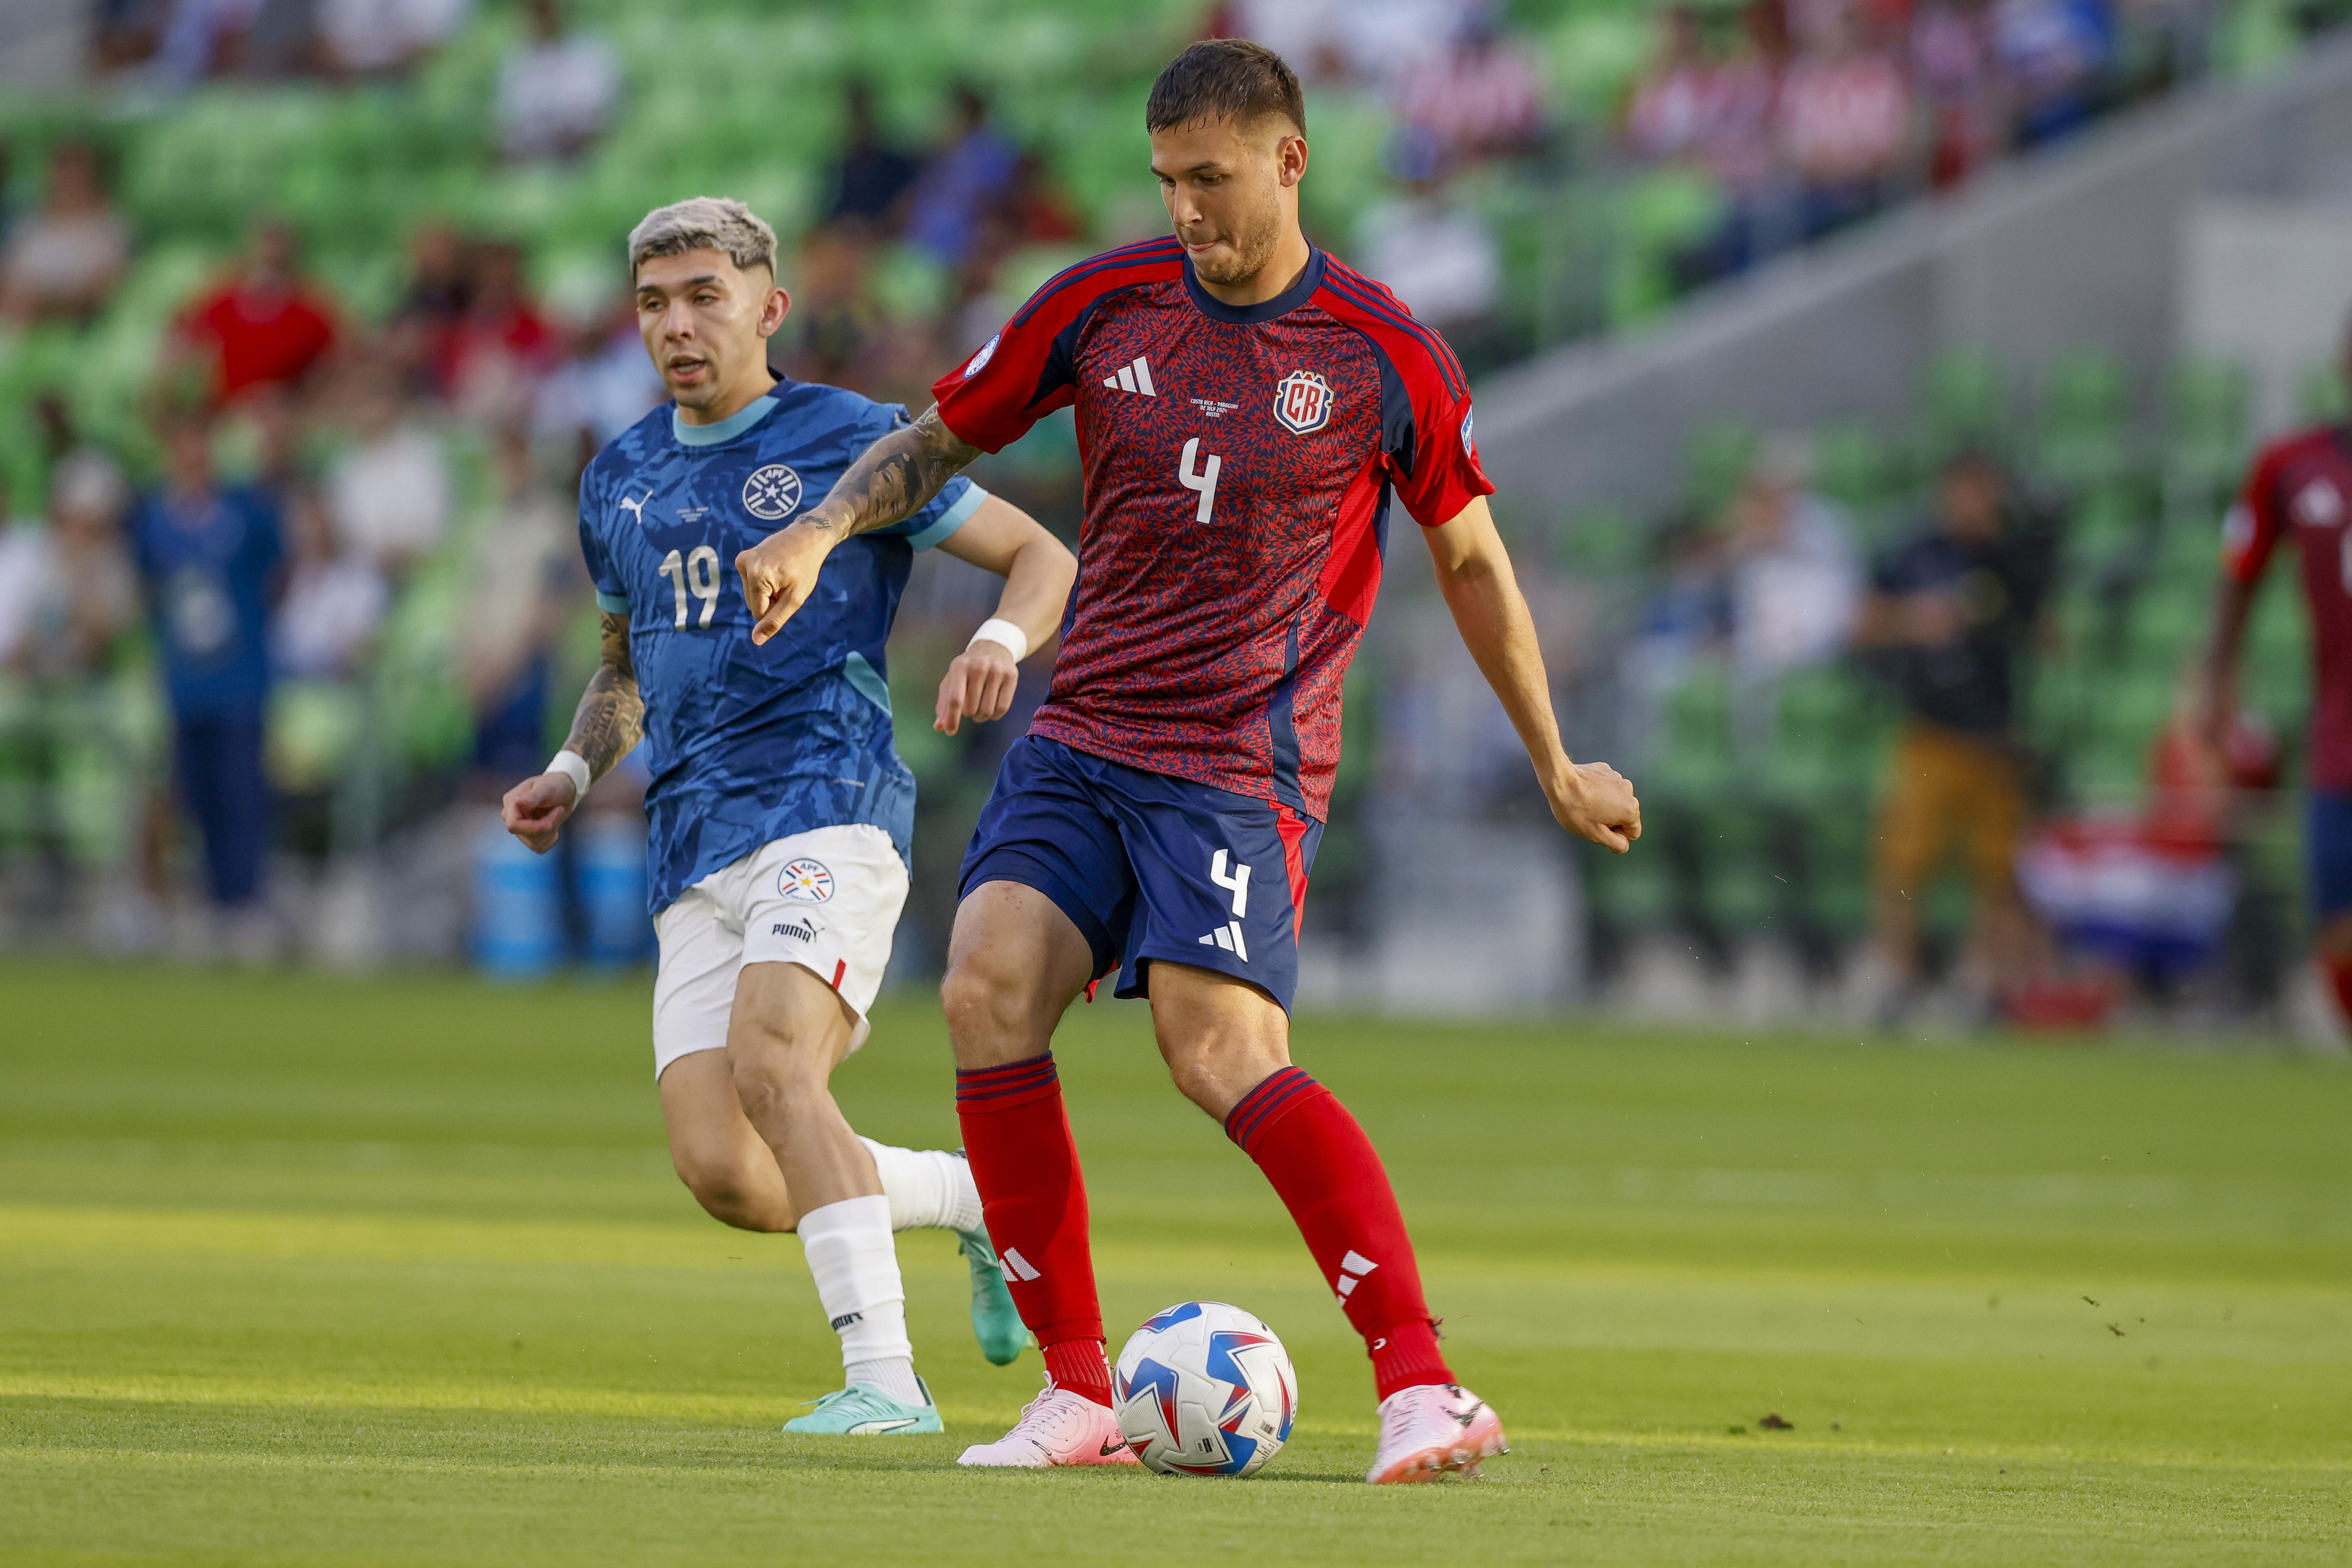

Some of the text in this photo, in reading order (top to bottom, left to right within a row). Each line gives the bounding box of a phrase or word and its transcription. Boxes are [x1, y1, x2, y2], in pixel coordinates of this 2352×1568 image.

[1287, 383, 1320, 422] CR
[1179, 438, 1221, 524] 4
[659, 545, 721, 632] 19
[1210, 849, 1251, 918] 4
[772, 924, 811, 943] PUMA
